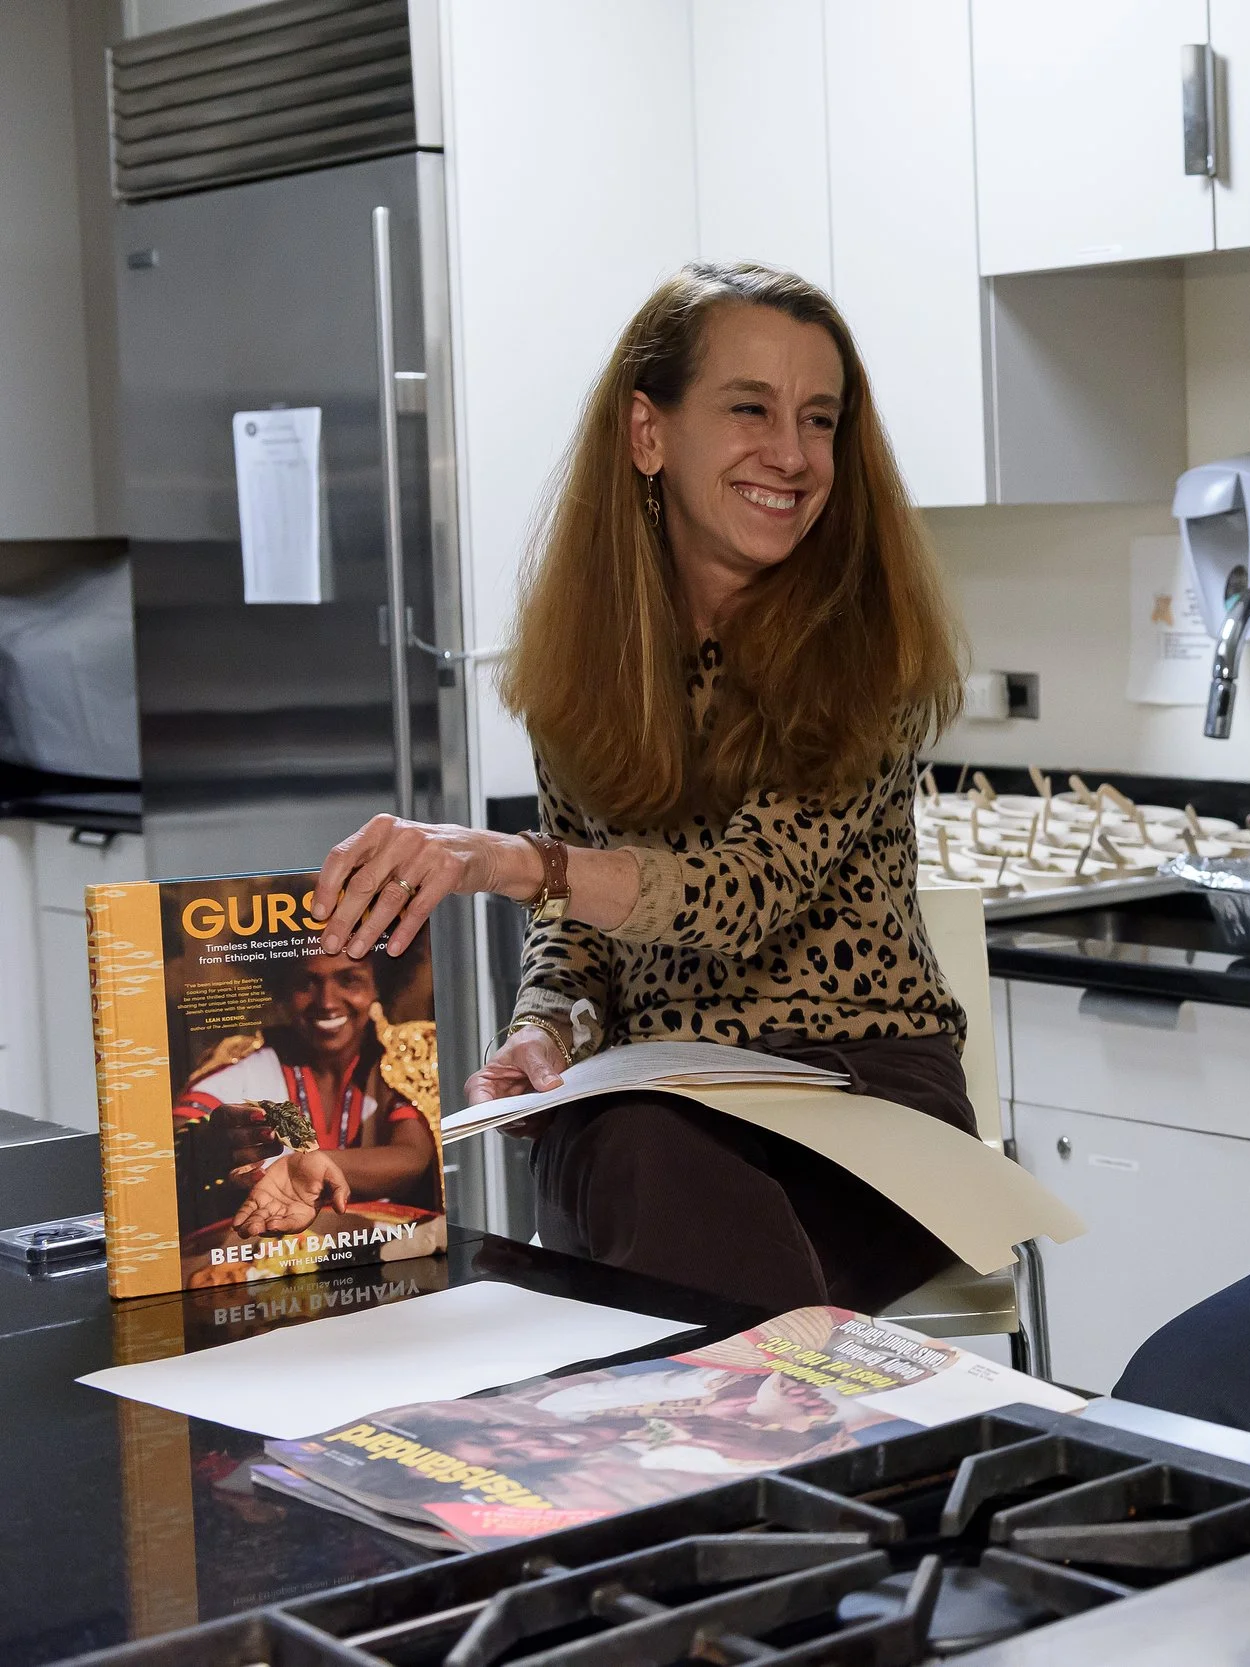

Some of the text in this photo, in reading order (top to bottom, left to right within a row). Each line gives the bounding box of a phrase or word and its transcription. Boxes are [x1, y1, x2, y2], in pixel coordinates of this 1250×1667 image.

[181, 887, 345, 939] GURS
[199, 947, 326, 965] from Ethiopia, Israel, Harl
[206, 942, 248, 953] Timeless
[250, 940, 289, 950] Recipes
[291, 937, 305, 946] for
[210, 1222, 418, 1266] BEEJHY BARHANY
[279, 1251, 353, 1268] WITH ELISA UNG
[882, 1334, 920, 1355] about
[756, 1336, 899, 1389] feast at the JCC
[914, 1346, 948, 1368] talks
[762, 1358, 869, 1396] An Ethiopian
